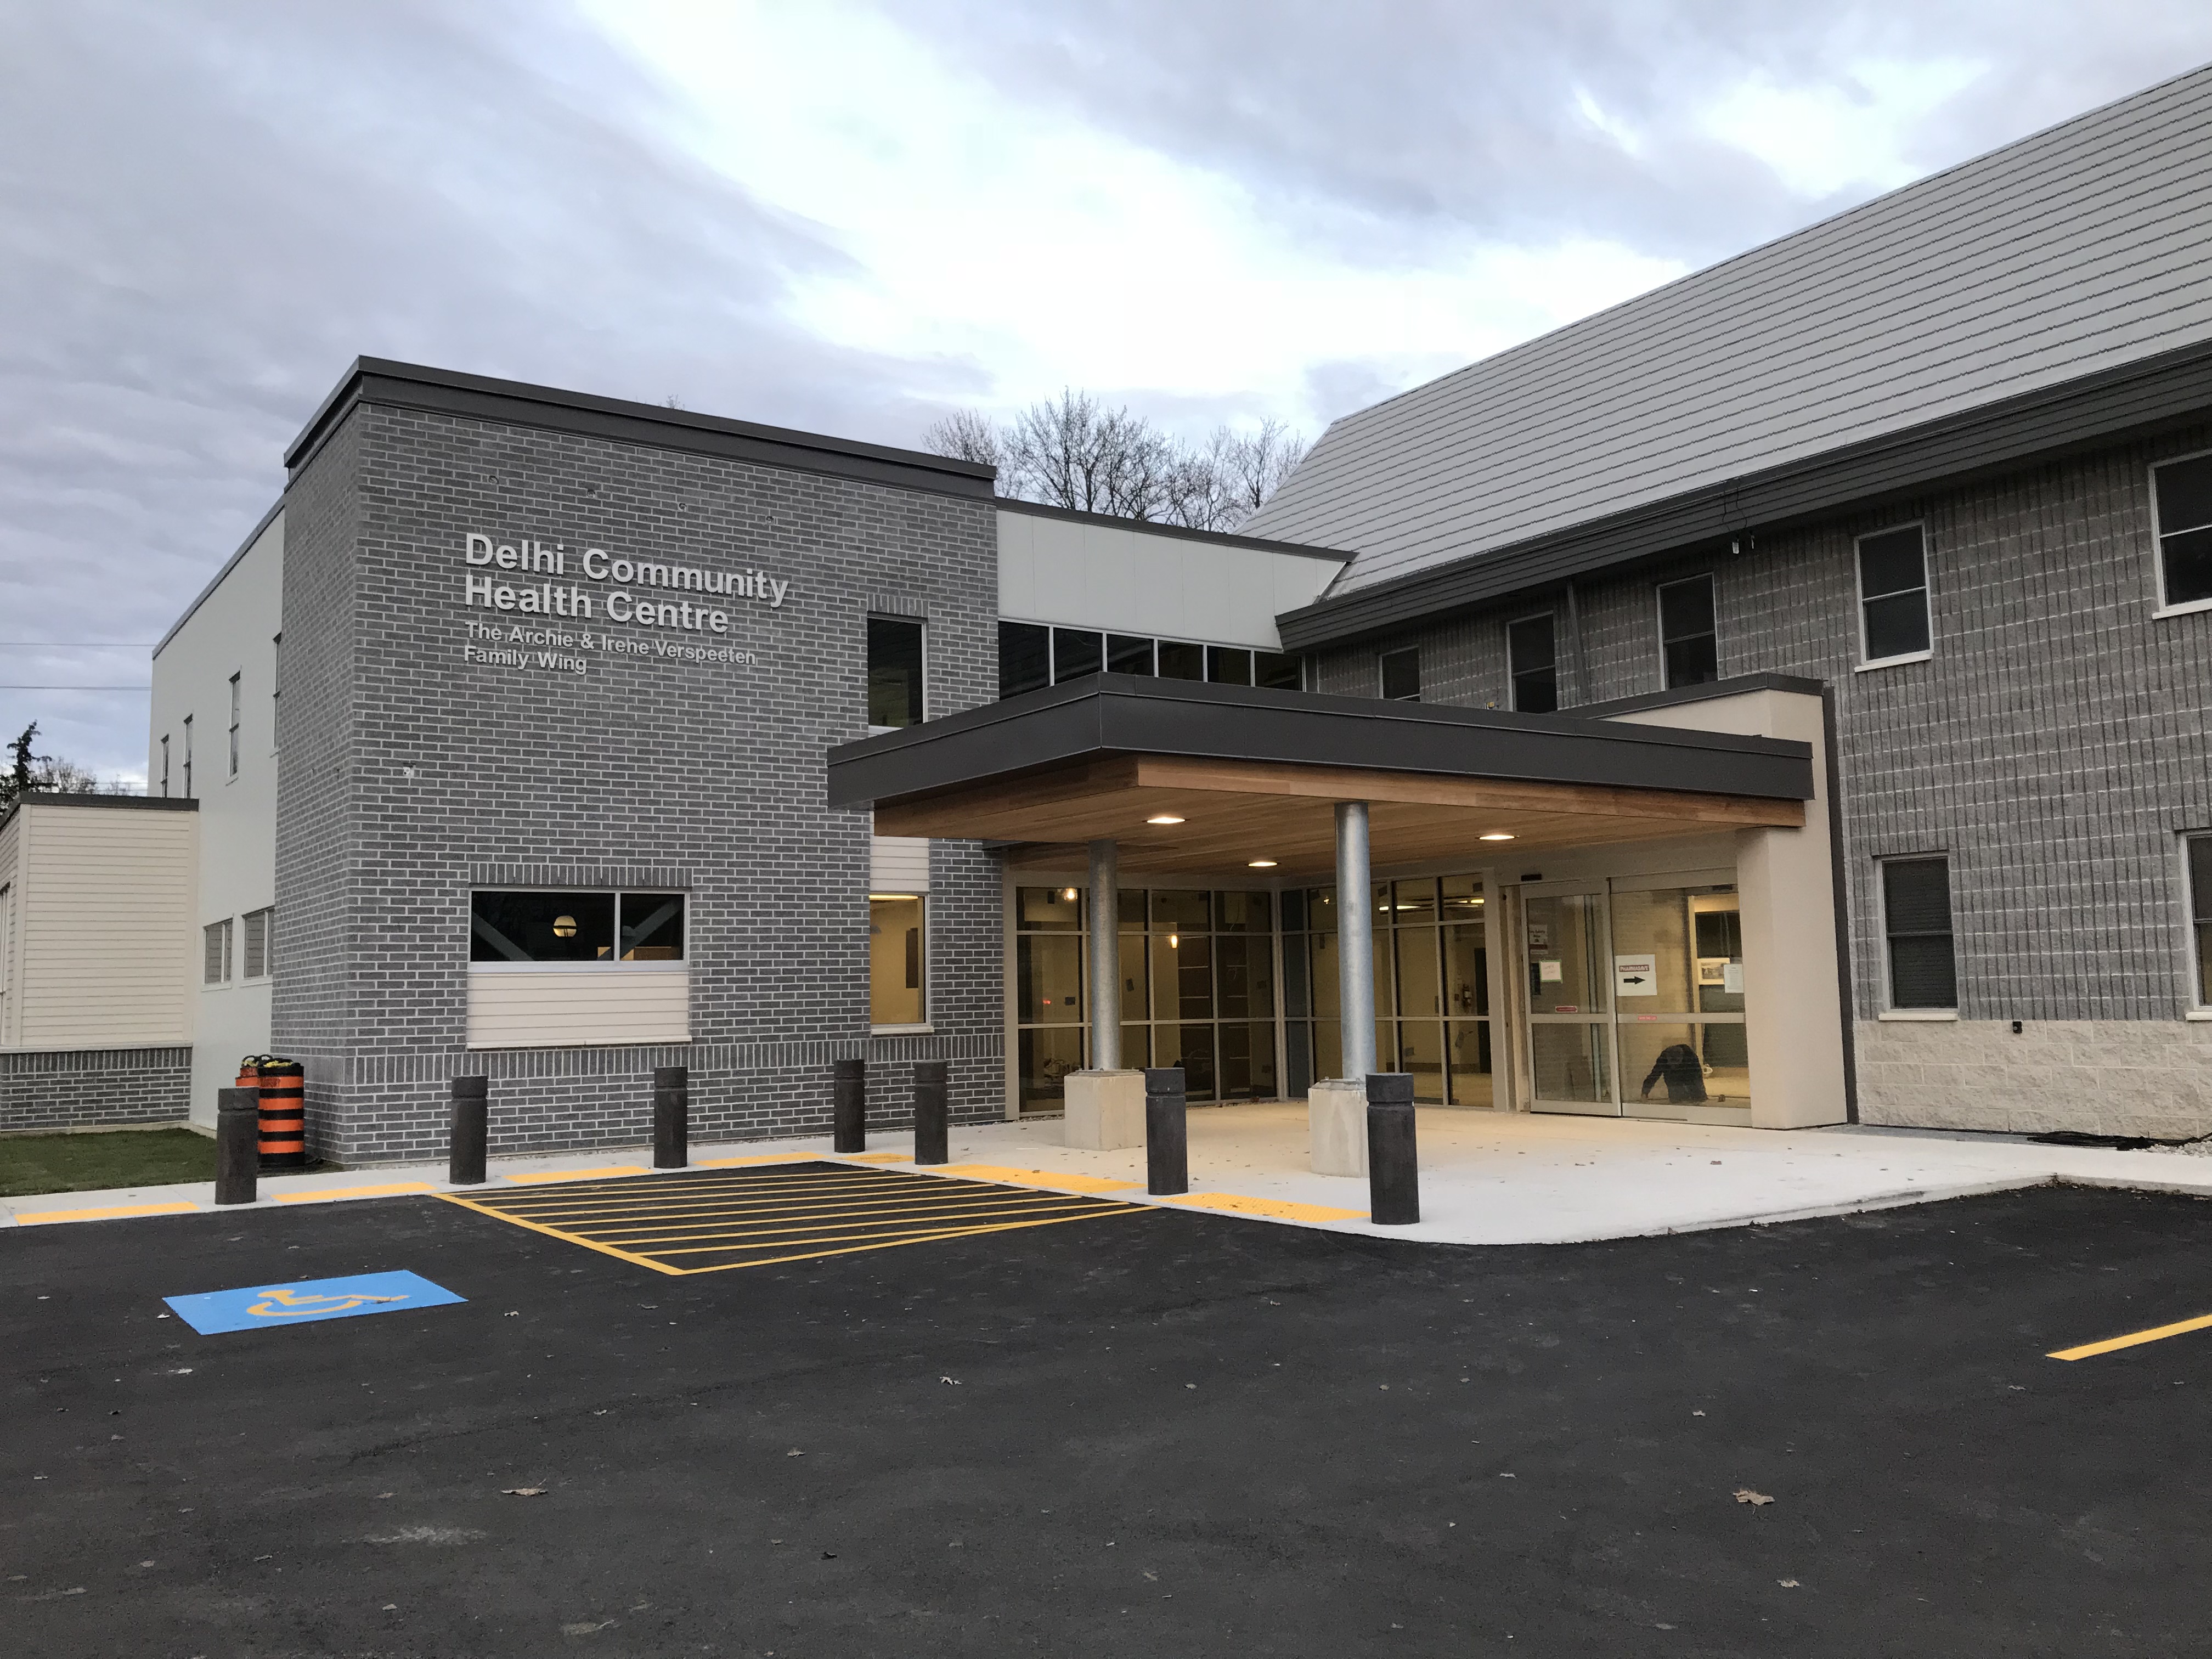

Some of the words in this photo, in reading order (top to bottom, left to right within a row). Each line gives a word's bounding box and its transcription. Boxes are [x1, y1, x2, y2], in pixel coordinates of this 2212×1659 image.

[466, 532, 564, 575] Delhi
[583, 548, 789, 608] Community
[465, 574, 591, 618] Health
[607, 591, 729, 633] Centre
[464, 645, 529, 670] Family
[537, 651, 587, 675] Wing
[465, 620, 502, 640] The
[509, 626, 573, 647] Archie
[580, 633, 594, 650] &
[602, 634, 649, 655] Irene
[654, 640, 755, 665] Verspeeten
